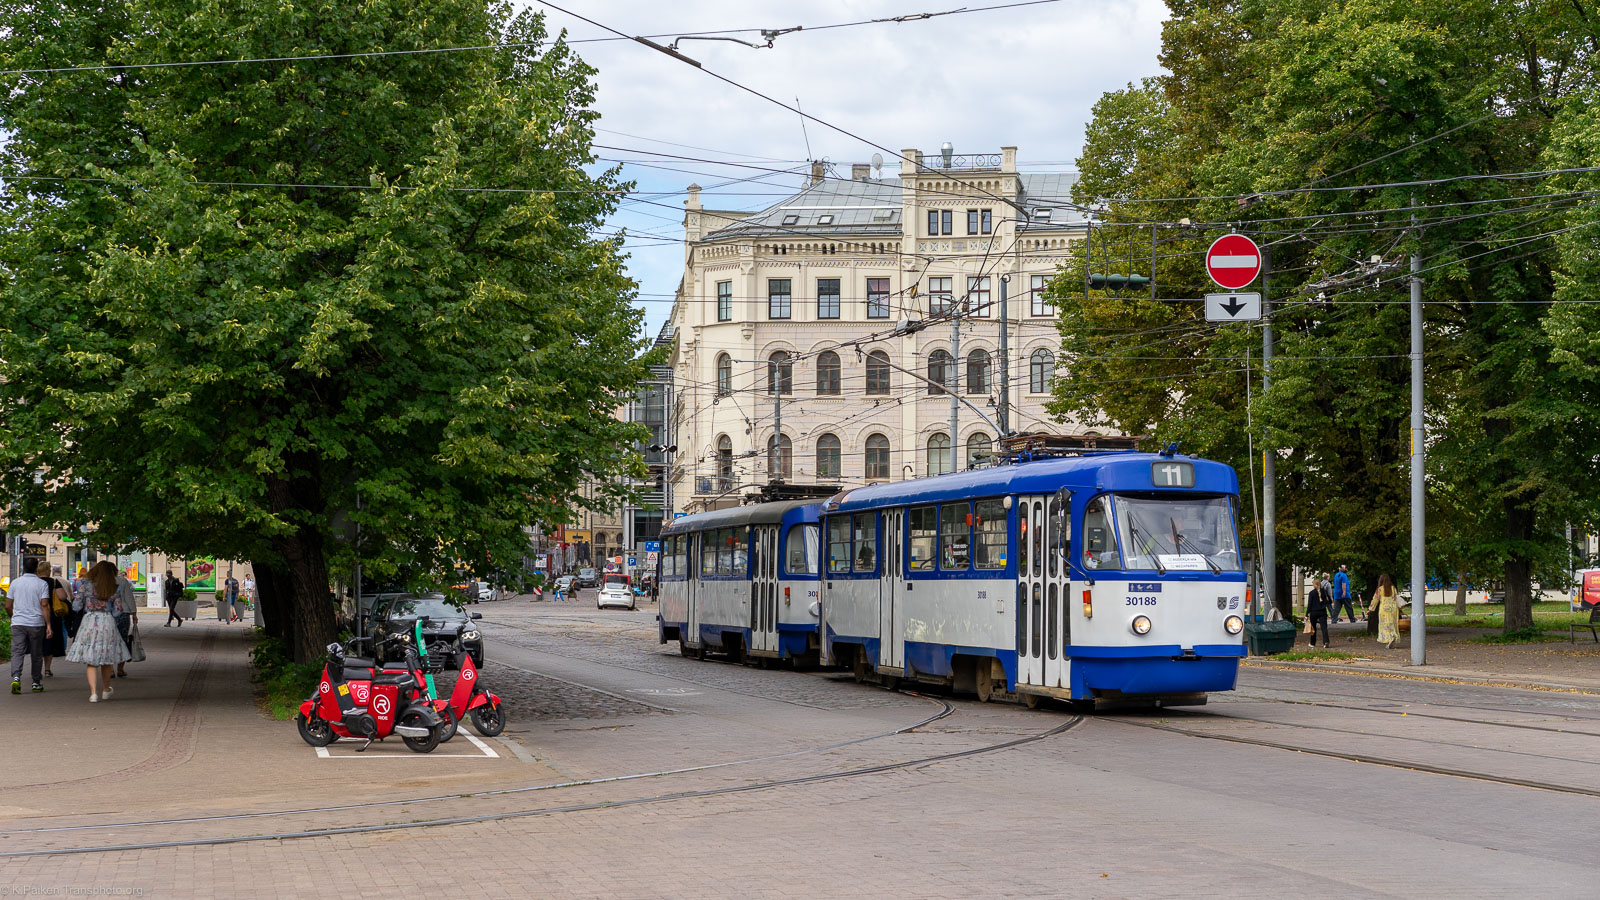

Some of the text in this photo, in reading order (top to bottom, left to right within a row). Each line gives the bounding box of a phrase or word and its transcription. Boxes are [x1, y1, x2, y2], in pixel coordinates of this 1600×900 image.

[1162, 465, 1182, 485] 11
[807, 590, 818, 598] 30
[1125, 596, 1157, 606] 30188
